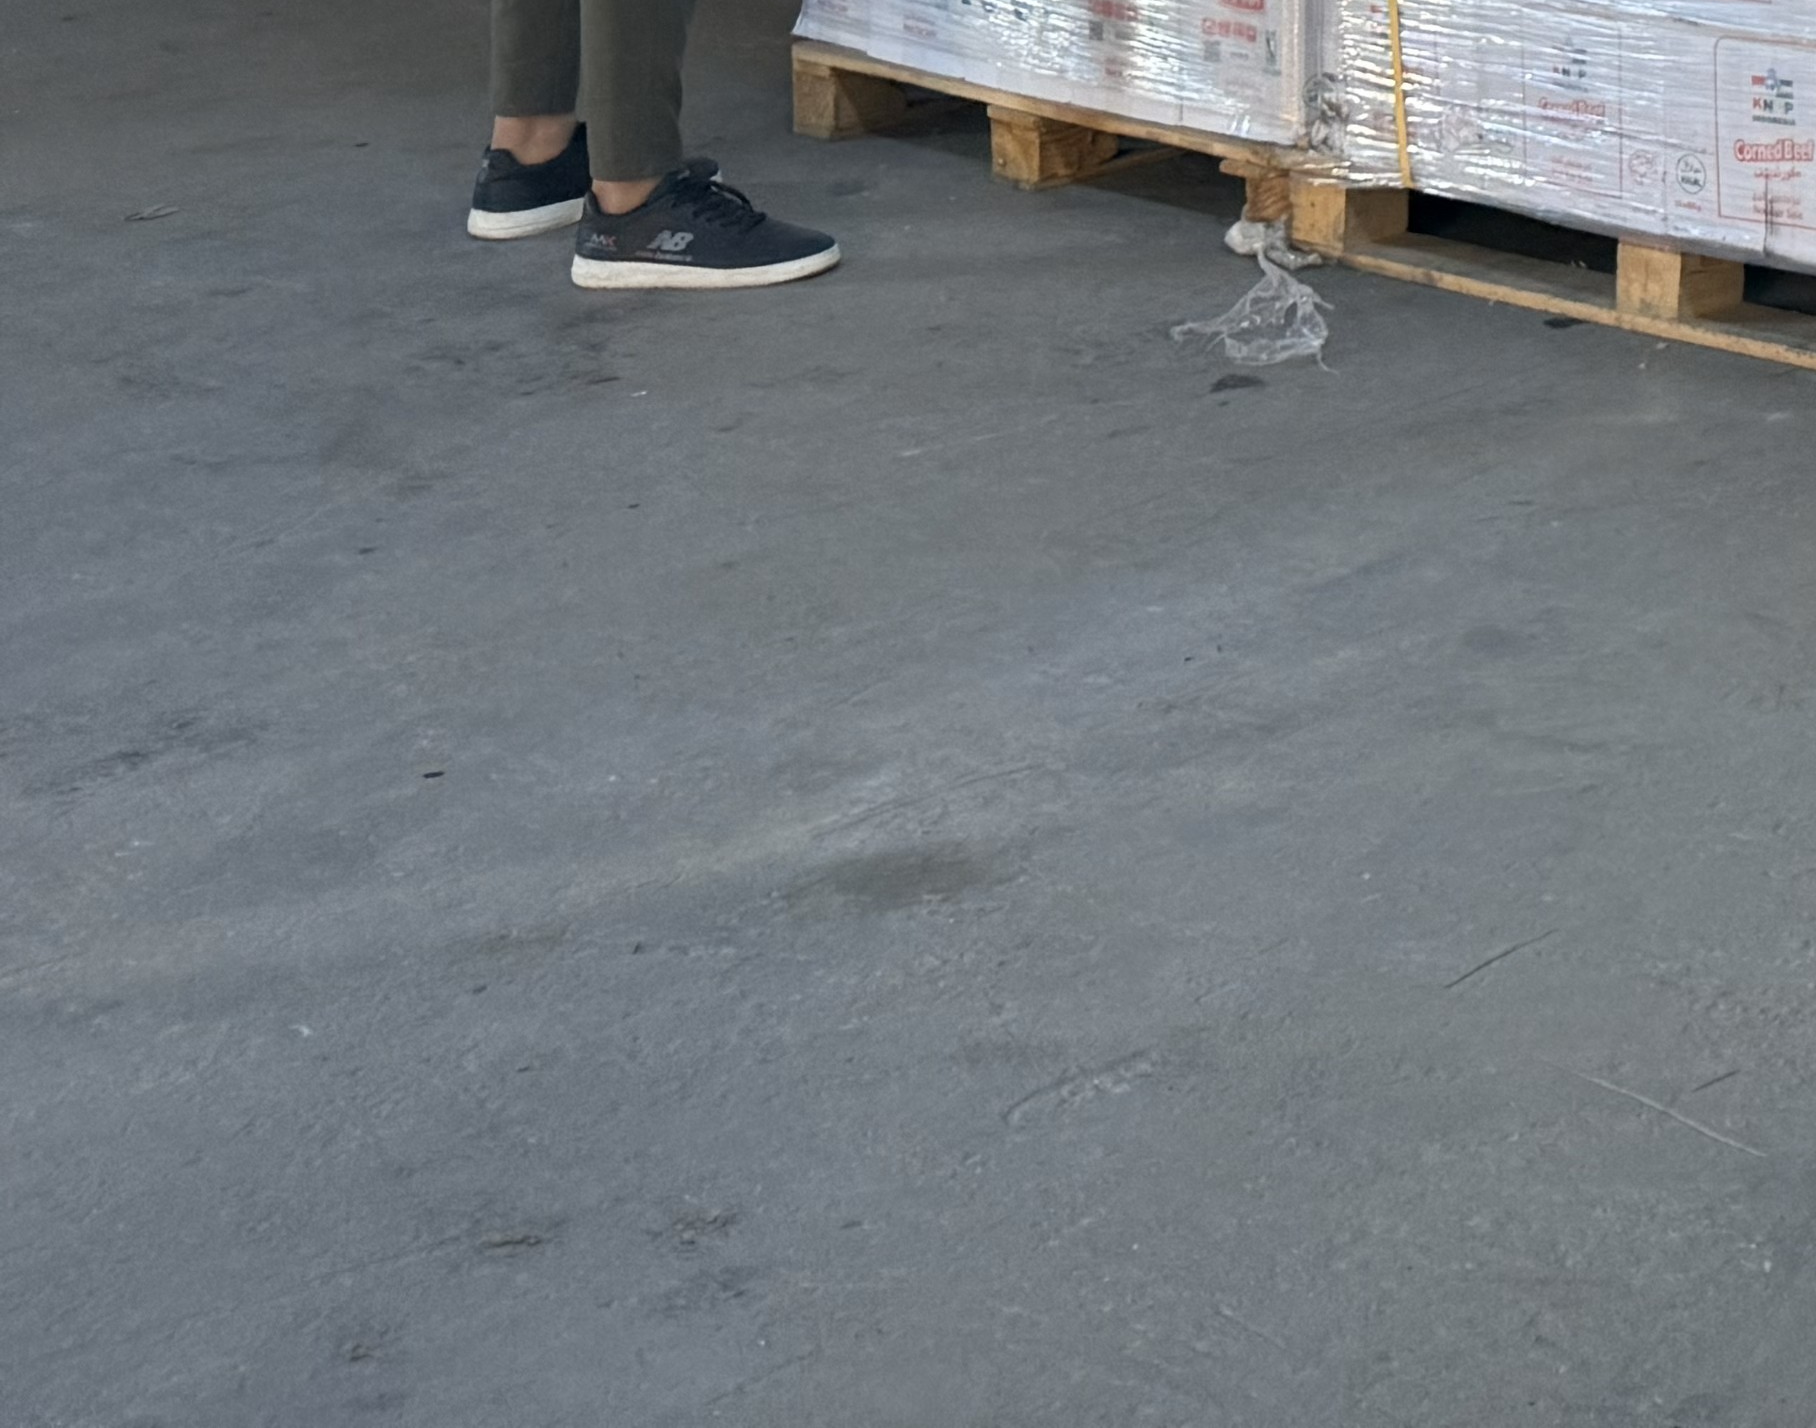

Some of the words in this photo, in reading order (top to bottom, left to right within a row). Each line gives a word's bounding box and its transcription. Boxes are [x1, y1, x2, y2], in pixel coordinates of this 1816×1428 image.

[1752, 95, 1795, 115] KNP
[1733, 137, 1785, 164] Corned
[1783, 138, 1815, 164] Beef
